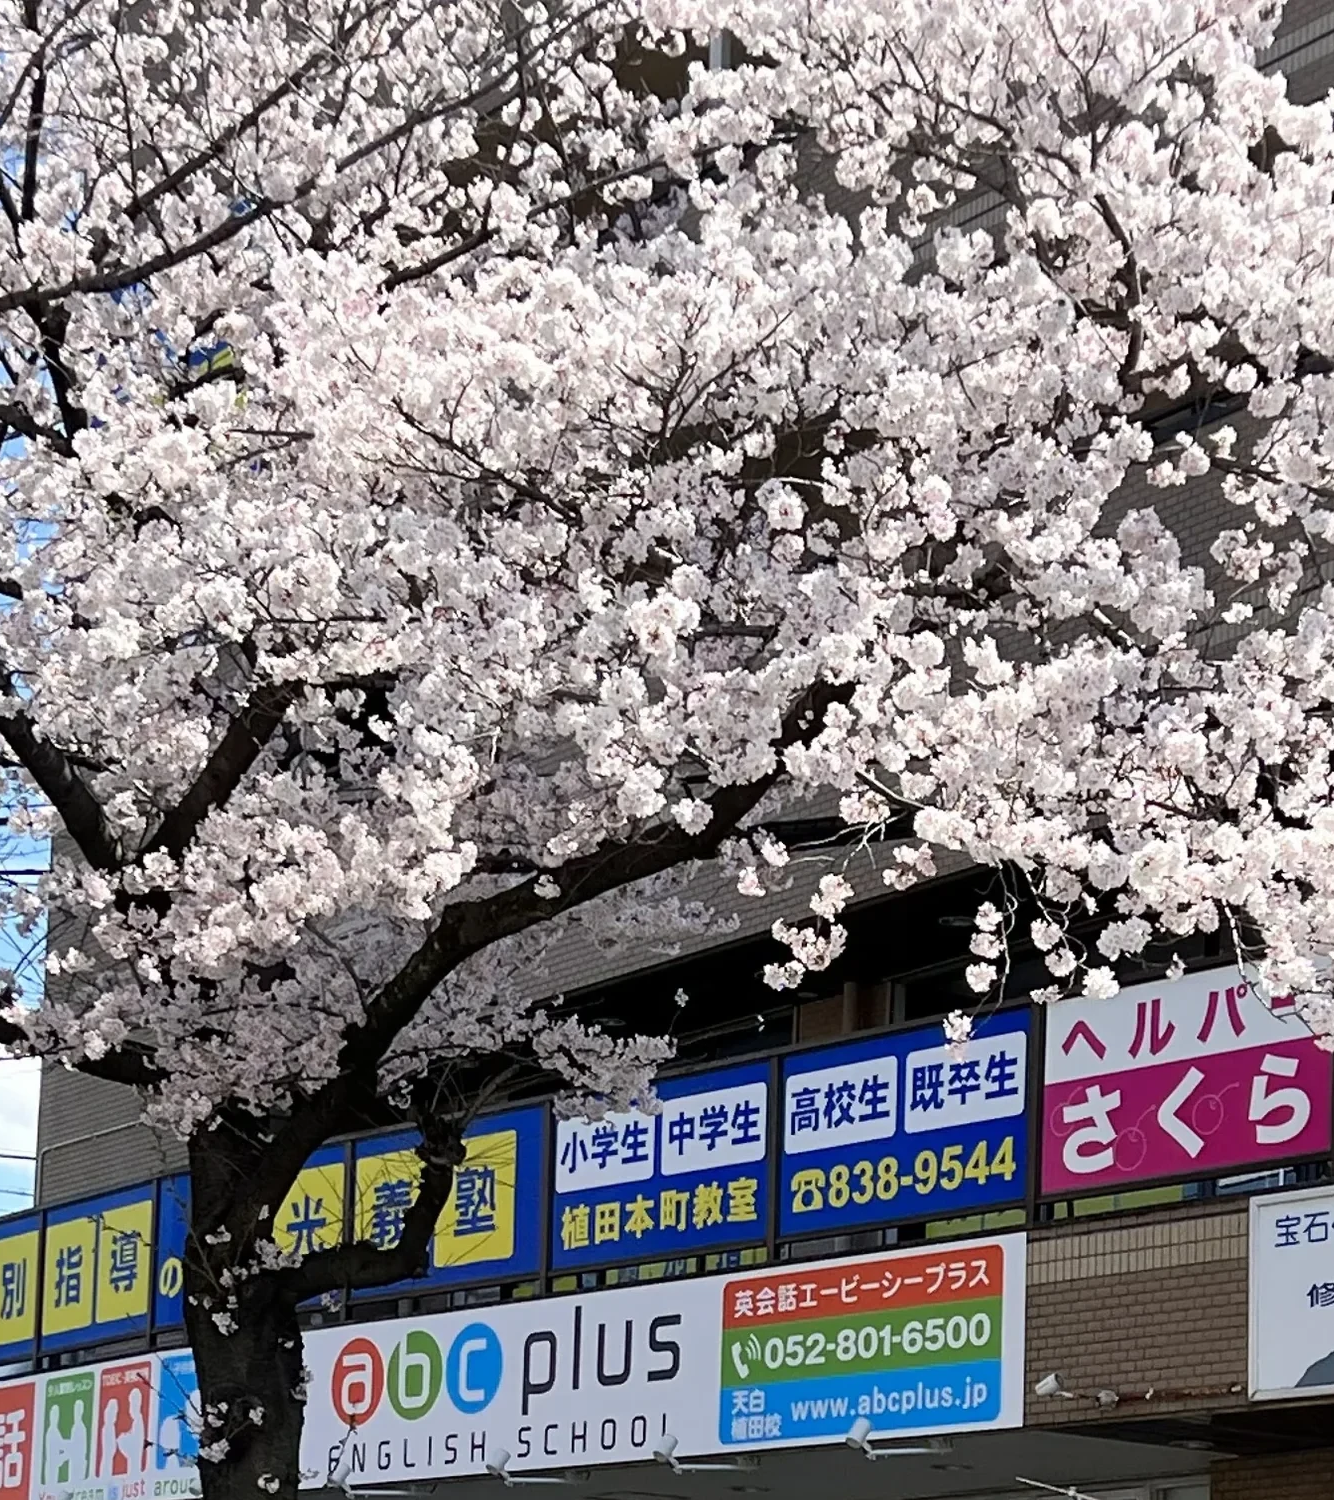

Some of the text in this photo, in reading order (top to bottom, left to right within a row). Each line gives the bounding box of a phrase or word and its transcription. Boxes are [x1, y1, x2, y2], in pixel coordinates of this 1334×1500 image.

[790, 1051, 1020, 1136] 高校生 既卒生
[561, 1100, 761, 1174] 小学生 中学生
[829, 1137, 1016, 1209] 838-9544
[561, 1177, 758, 1250] 植田本町教室
[734, 1260, 989, 1318] 英会話エービーシープラス
[338, 1305, 682, 1419] abc plus
[764, 1313, 991, 1369] 052-801-6500
[731, 1389, 765, 1414] 天白
[731, 1414, 782, 1442] 植田校
[791, 1377, 987, 1422] www.abcplus.jp
[328, 1430, 486, 1472] ENGLISH
